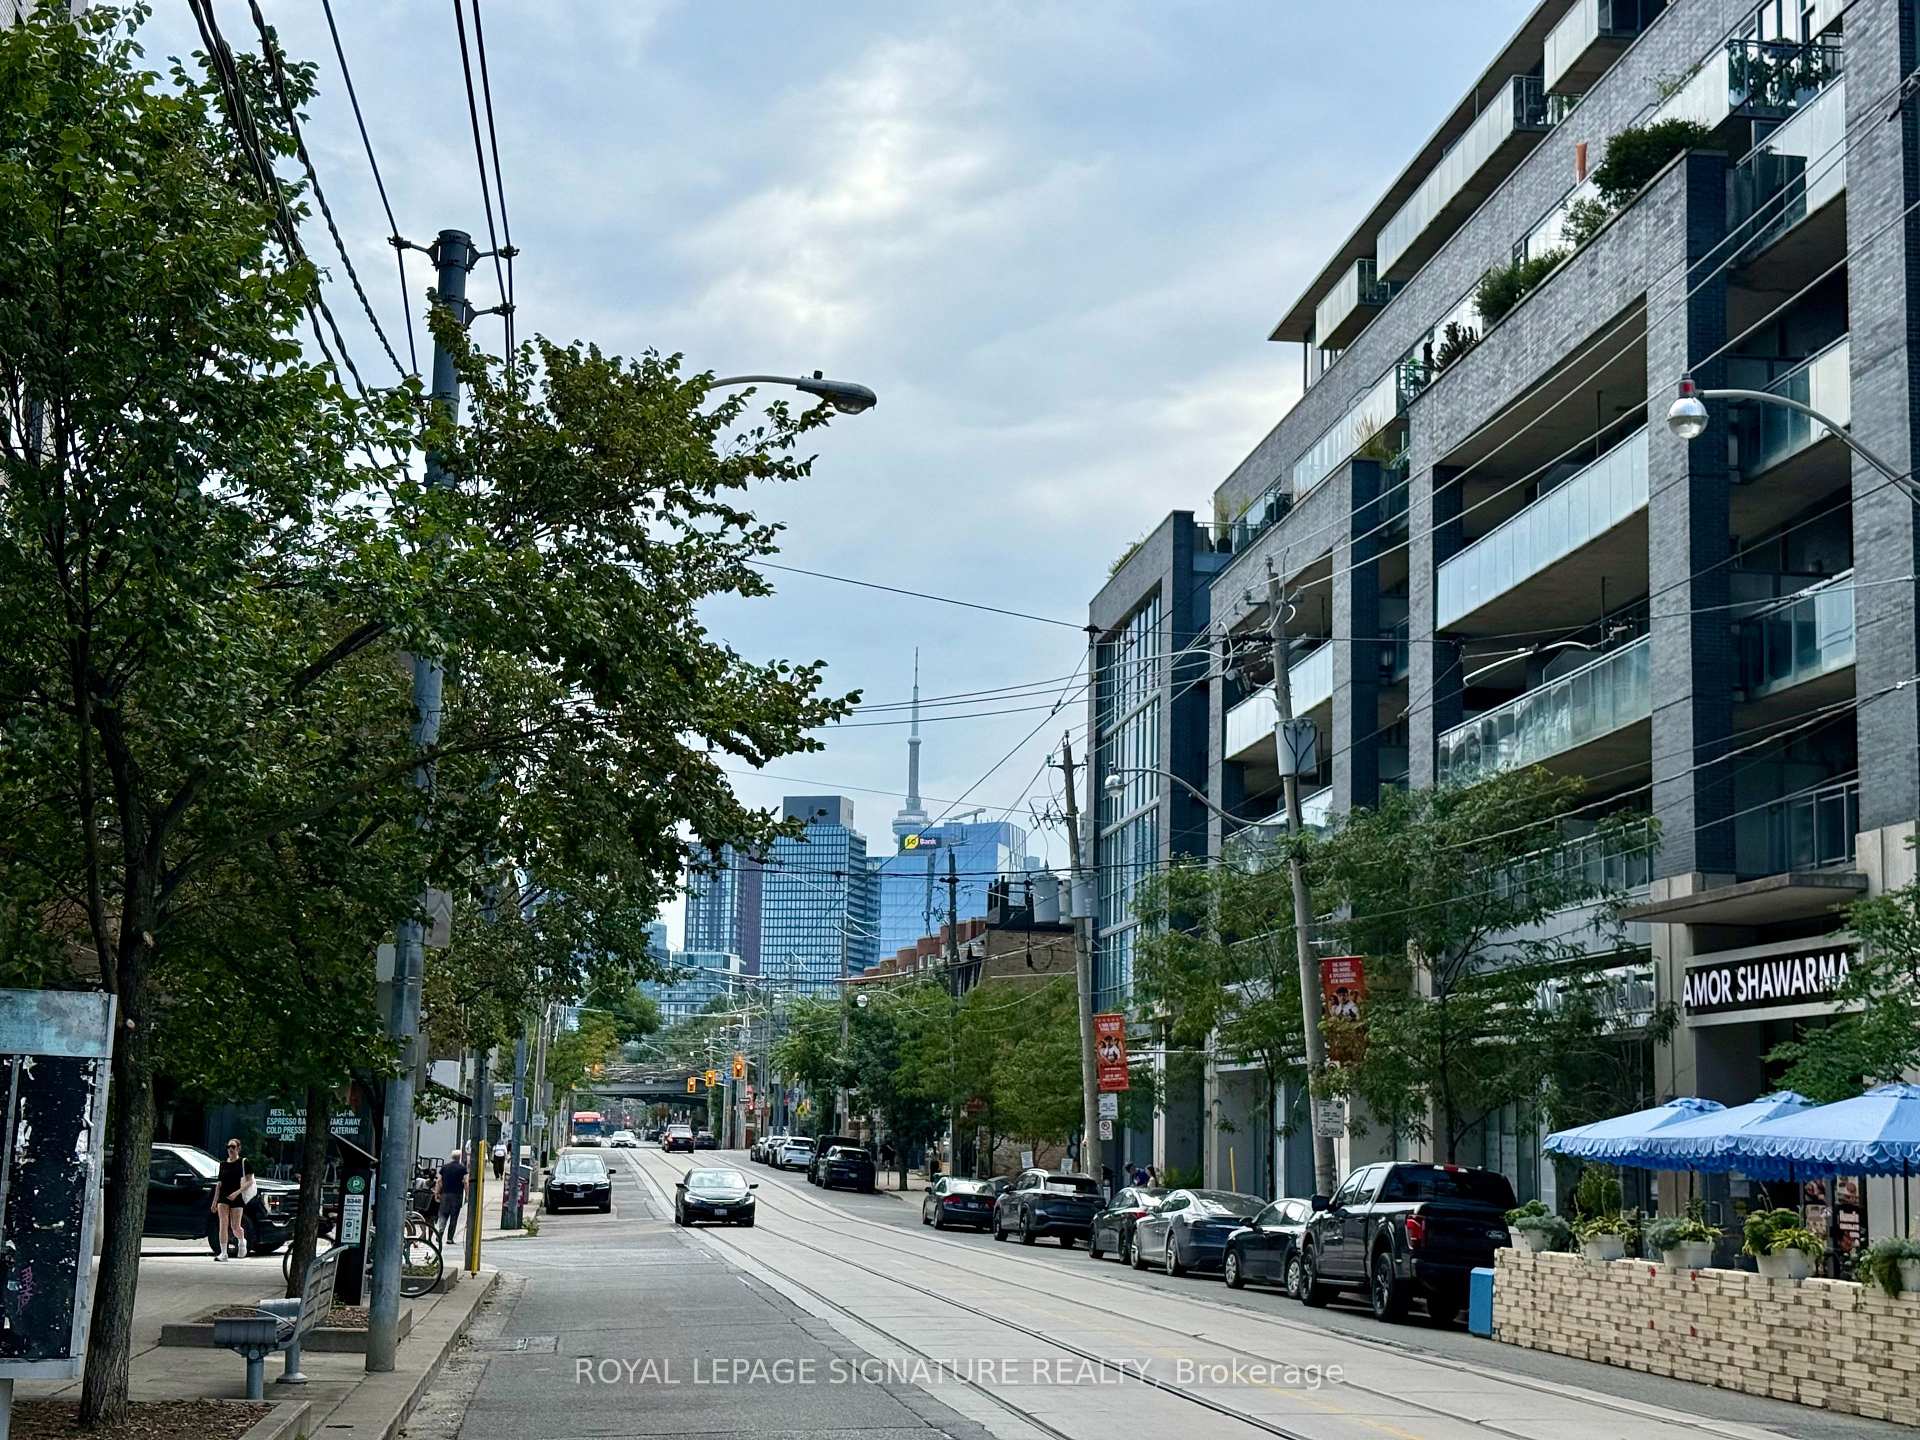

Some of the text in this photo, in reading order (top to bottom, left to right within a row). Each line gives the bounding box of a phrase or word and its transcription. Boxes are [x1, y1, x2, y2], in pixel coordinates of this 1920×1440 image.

[1682, 969, 1733, 1007] AMOR
[1737, 952, 1852, 1001] SHAWARMA
[266, 1117, 297, 1126] ESPRESSO
[282, 1127, 307, 1135] PRESSE
[330, 1126, 359, 1134] CATERING
